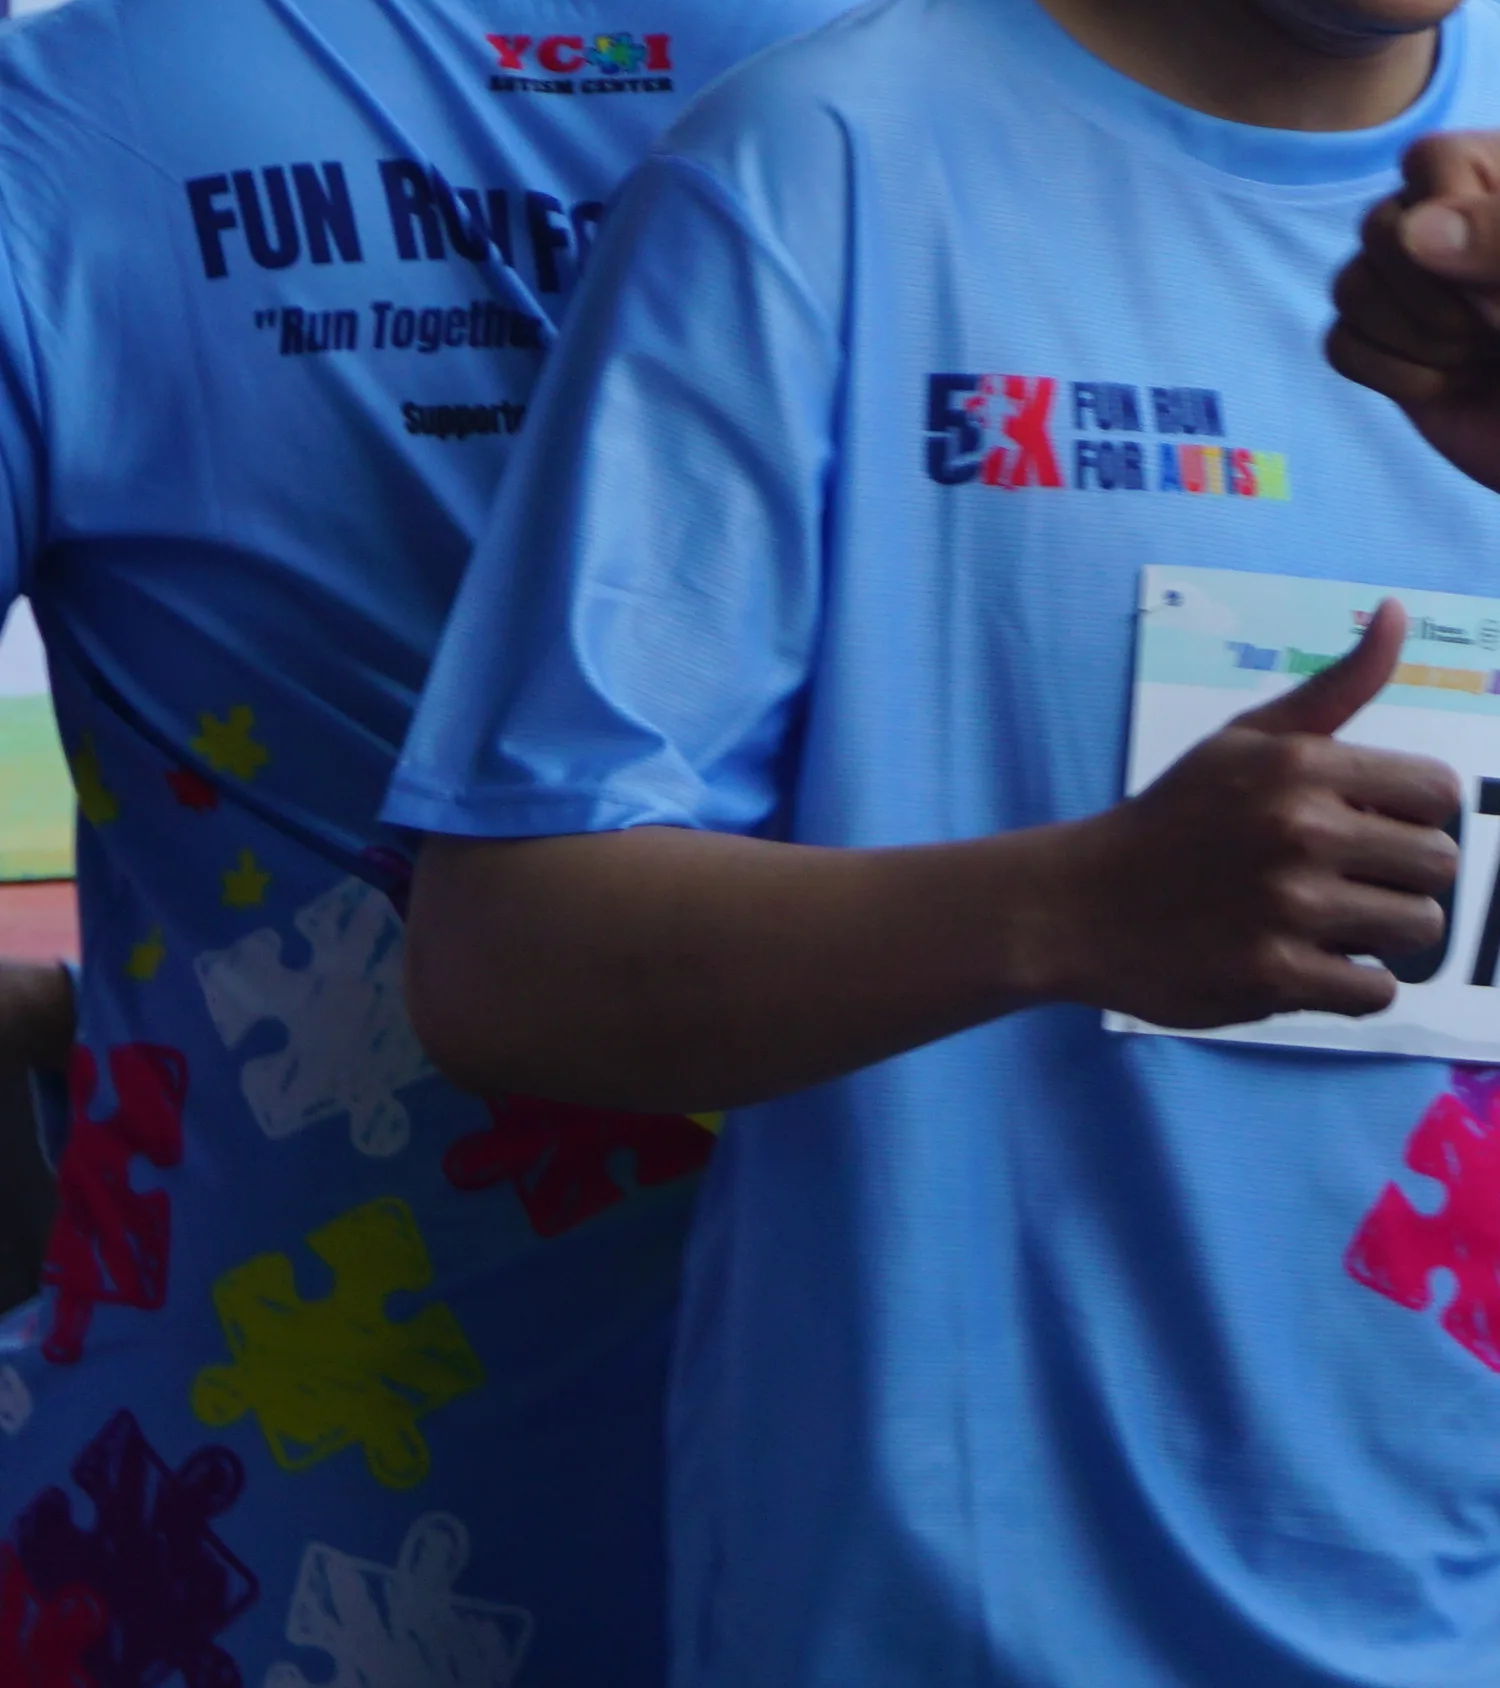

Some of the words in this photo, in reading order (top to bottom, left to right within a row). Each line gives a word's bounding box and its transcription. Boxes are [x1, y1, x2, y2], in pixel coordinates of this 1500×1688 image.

[184, 160, 364, 281] FUN
[1070, 381, 1144, 432] FUN
[1149, 386, 1226, 437] RUN
[1075, 439, 1147, 492] FOR
[1159, 443, 1292, 502] AUTISM
